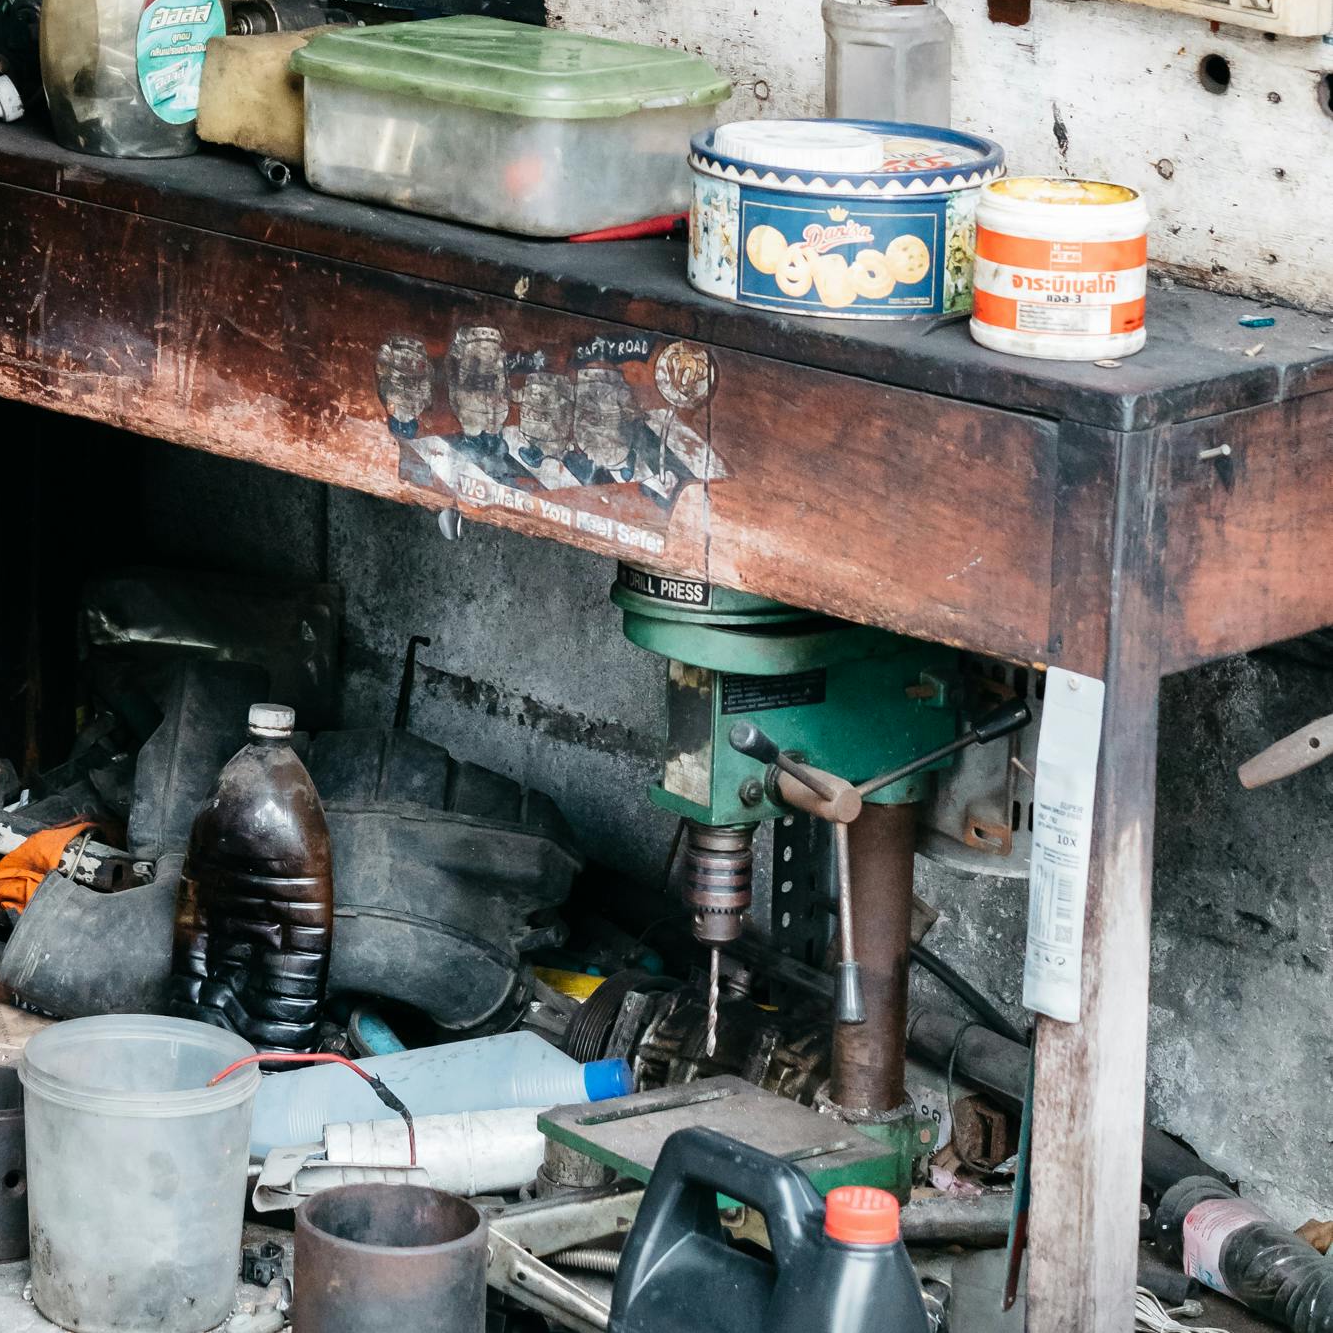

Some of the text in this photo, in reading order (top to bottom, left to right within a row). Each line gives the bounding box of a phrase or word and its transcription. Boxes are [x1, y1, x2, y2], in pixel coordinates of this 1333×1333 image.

[802, 218, 876, 254] Danisa
[576, 339, 649, 360] SAFTY ROAD
[493, 486, 535, 513] Make
[538, 501, 572, 526] You
[615, 522, 665, 554] Safer
[659, 580, 703, 604] PRESS
[1056, 833, 1078, 847] 10X
